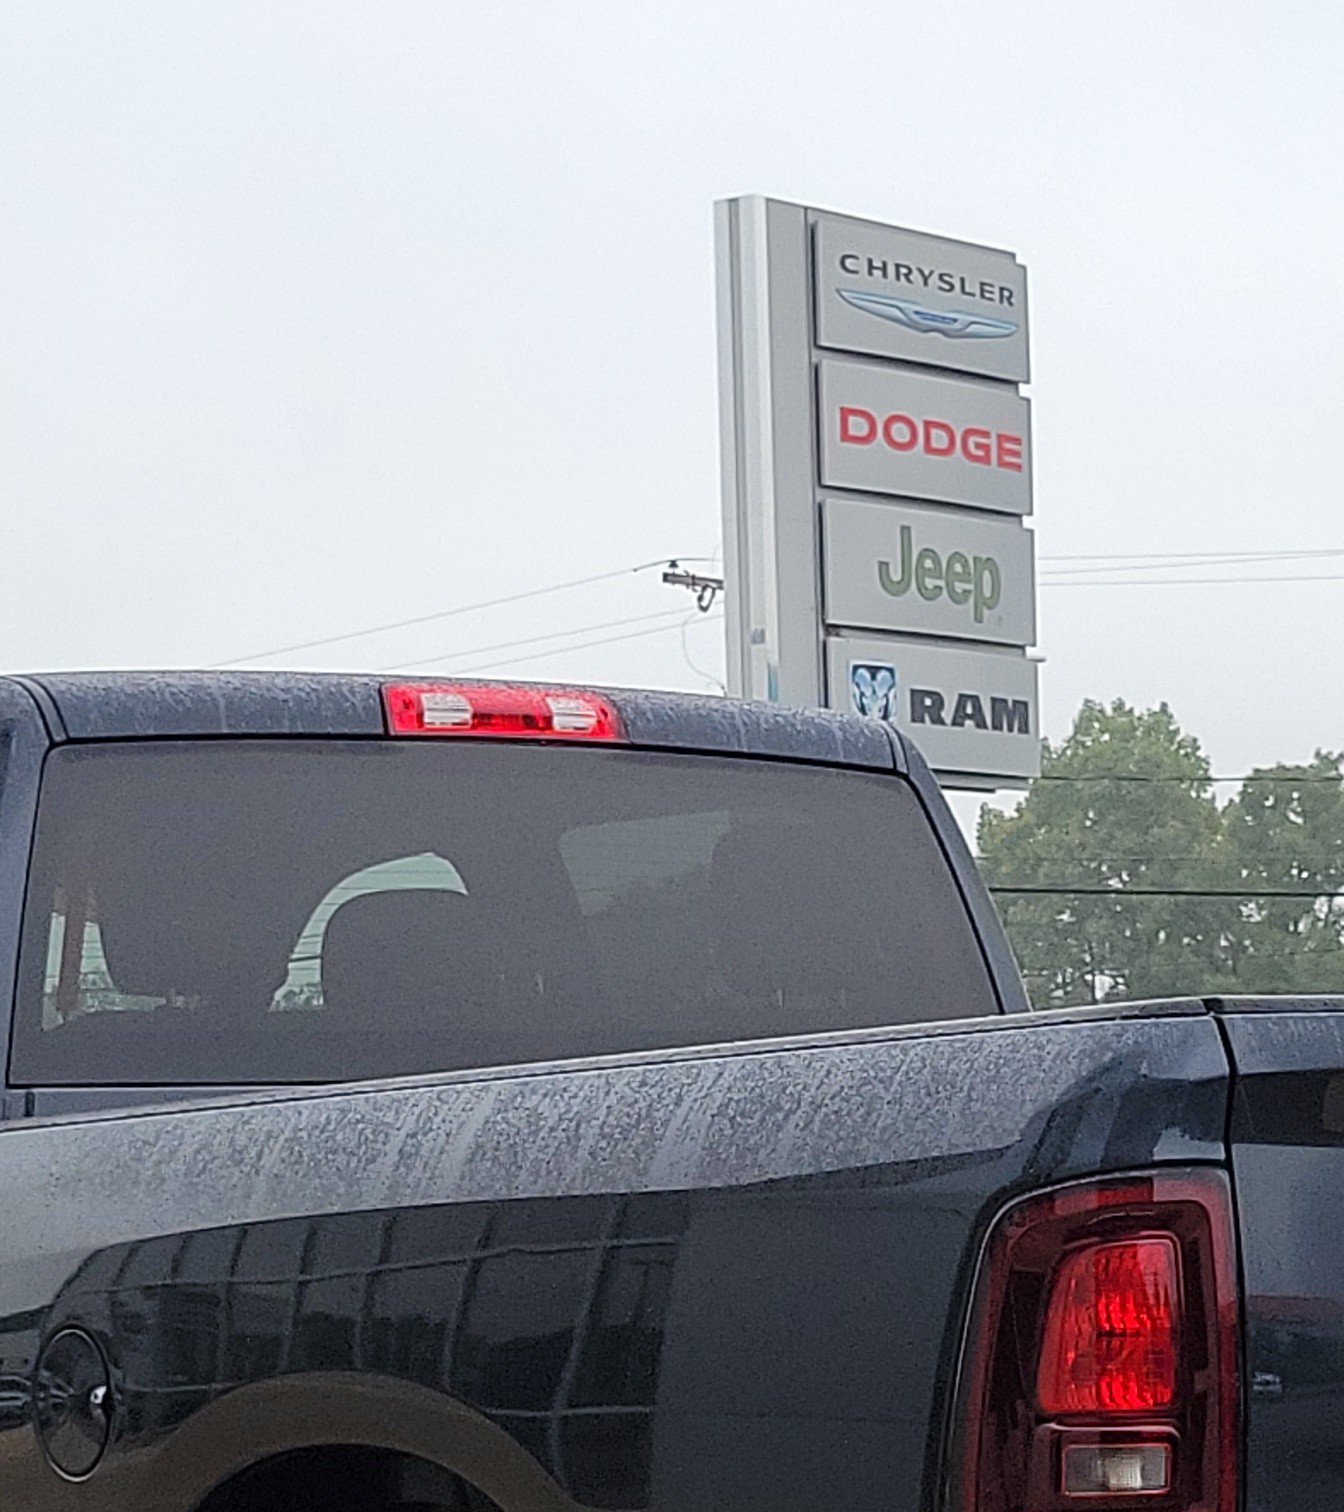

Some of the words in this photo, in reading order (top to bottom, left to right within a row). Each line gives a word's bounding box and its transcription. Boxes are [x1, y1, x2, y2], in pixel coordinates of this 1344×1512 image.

[839, 254, 1014, 307] CHRYSLER
[839, 406, 1022, 473] DODGE
[878, 525, 1001, 623] Jeep
[909, 688, 1029, 734] RAM
